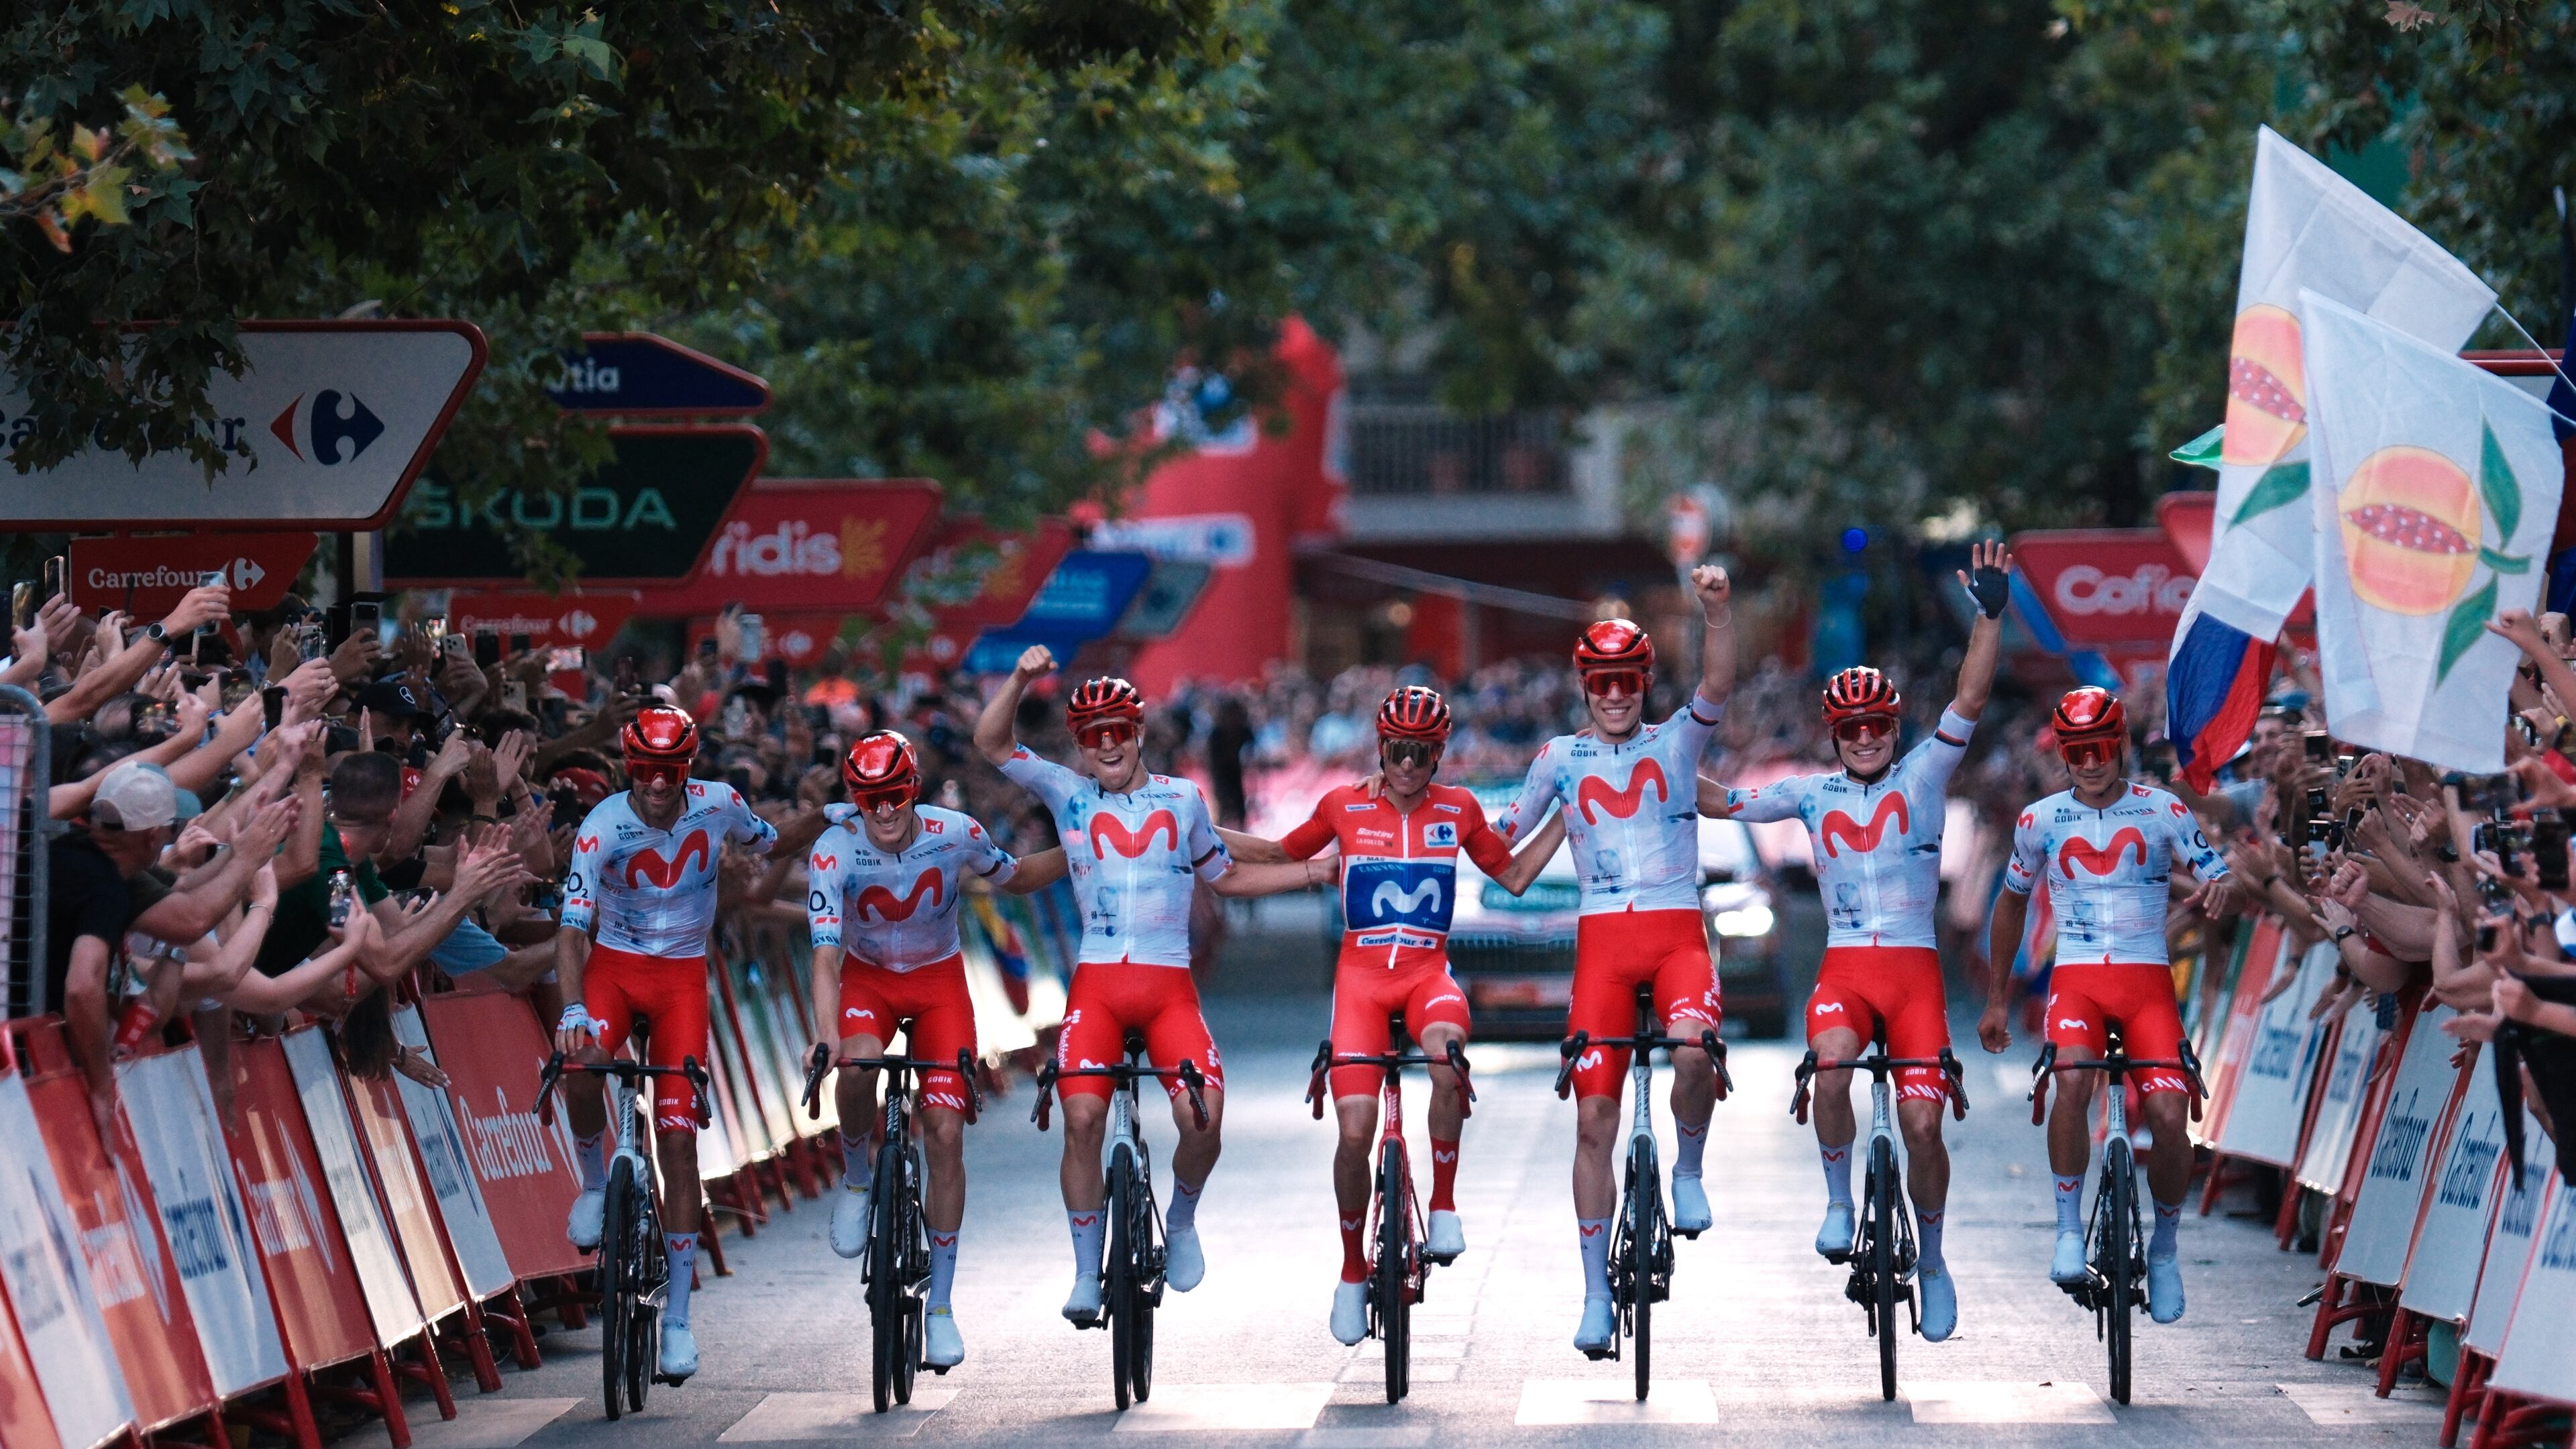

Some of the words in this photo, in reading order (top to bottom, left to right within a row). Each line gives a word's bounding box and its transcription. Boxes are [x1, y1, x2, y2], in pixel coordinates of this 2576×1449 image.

[1823, 784, 1847, 794] GOBIK
[2113, 807, 2154, 816] CANYON
[2055, 814, 2082, 823] GOBIK
[1356, 827, 1394, 839] Santini
[911, 842, 955, 859] CANYON
[856, 858, 881, 866] GOBIK
[1906, 1068, 1927, 1076] GOBIK
[659, 1098, 679, 1106] GOBIK
[459, 1086, 553, 1182] Carrefour
[2371, 1087, 2428, 1182] Carrefour
[2440, 1110, 2500, 1210] Carrefour
